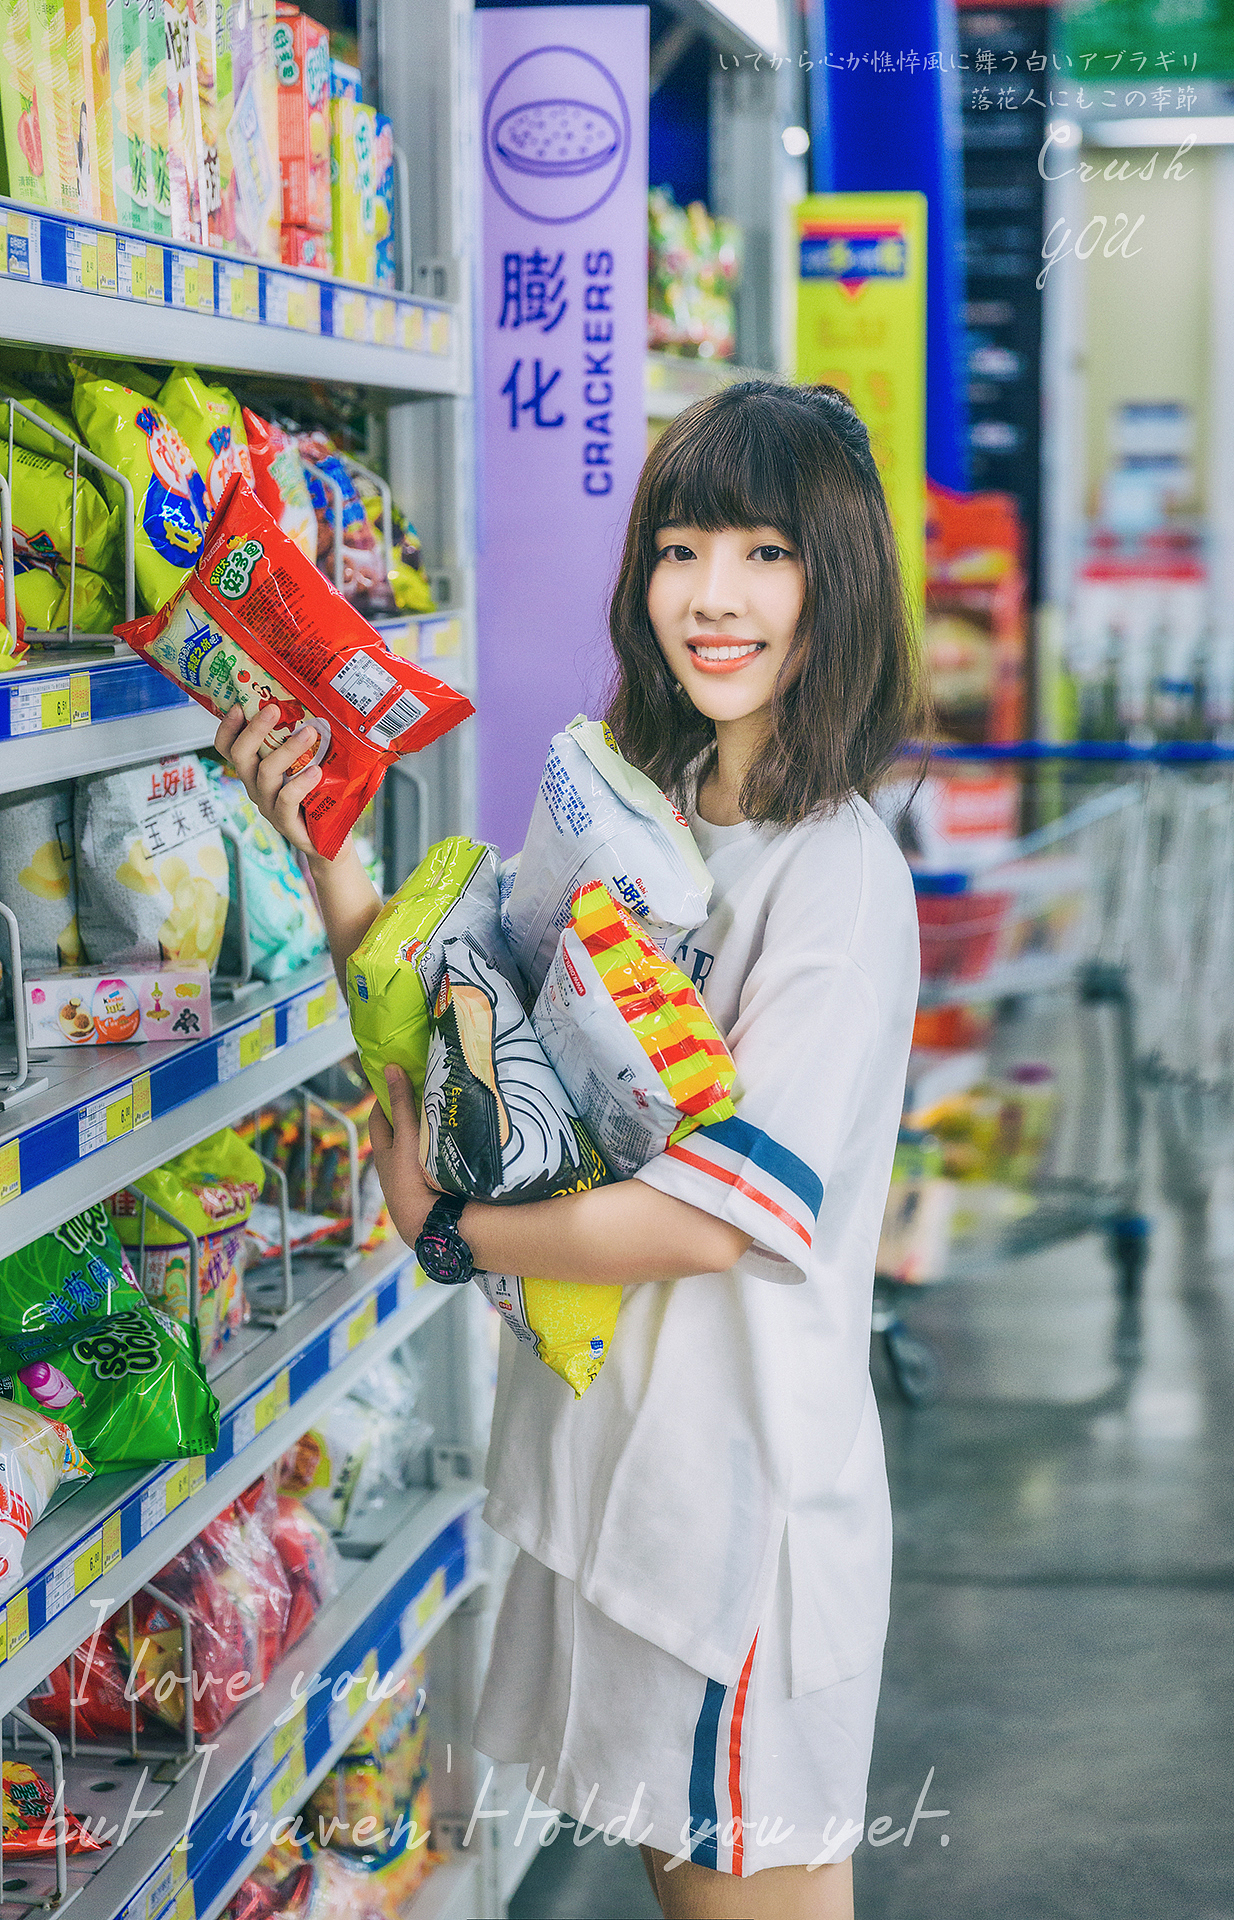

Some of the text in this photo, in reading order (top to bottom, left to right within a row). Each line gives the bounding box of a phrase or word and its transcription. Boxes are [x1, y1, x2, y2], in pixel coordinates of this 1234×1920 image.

[499, 246, 568, 431] 膨化
[582, 248, 616, 498] CRACKERS
[146, 764, 197, 802] 上好佳
[611, 874, 651, 920] 上好佳
